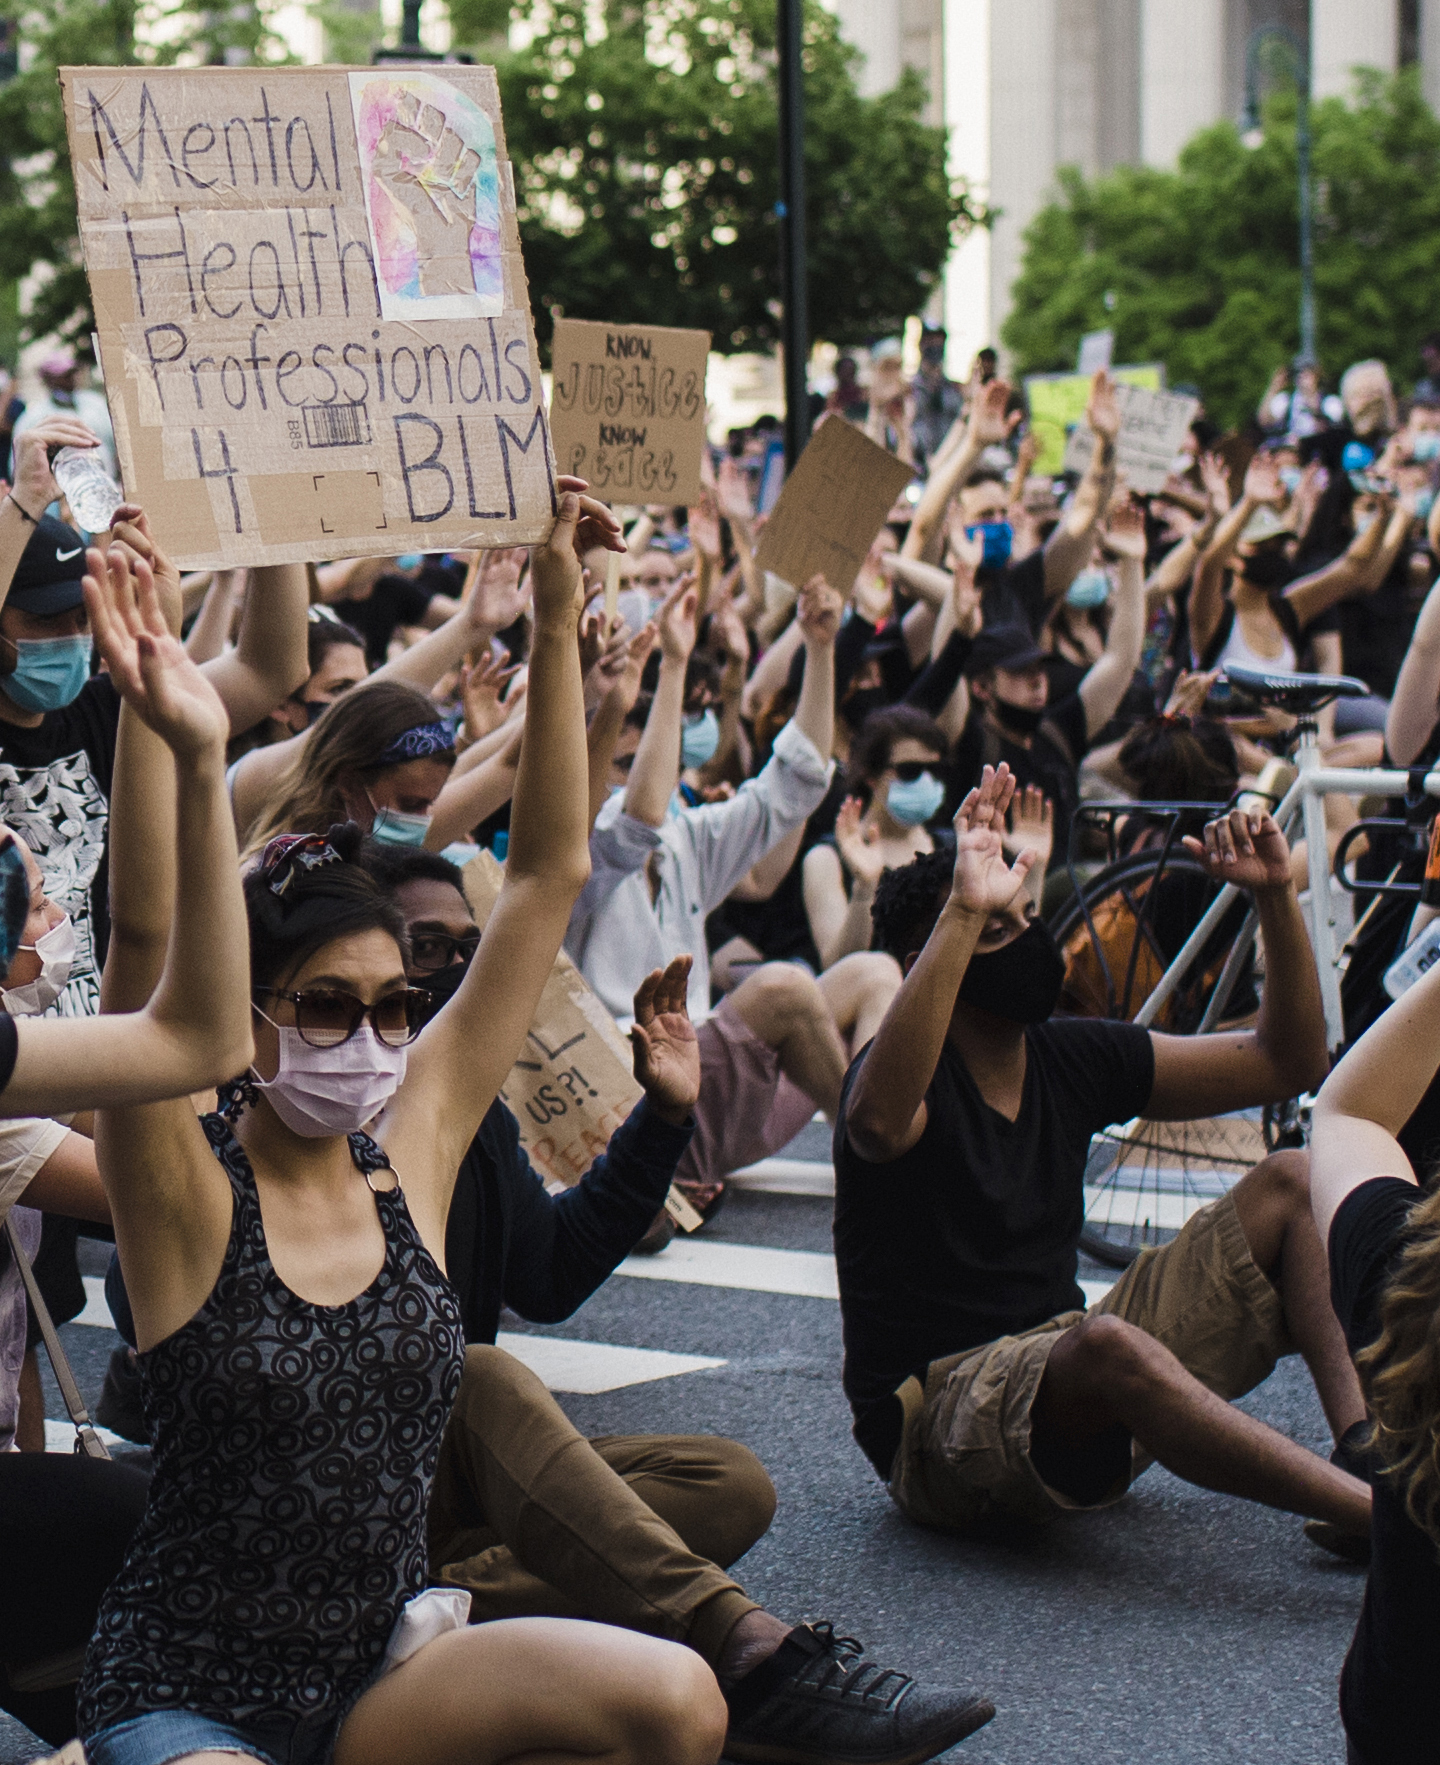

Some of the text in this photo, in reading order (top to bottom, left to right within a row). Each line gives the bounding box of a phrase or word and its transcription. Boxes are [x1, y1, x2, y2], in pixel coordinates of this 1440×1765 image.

[87, 81, 342, 193] Mental
[123, 204, 383, 321] Health
[144, 317, 533, 412] Professionals
[191, 405, 558, 533] 4 BLM
[599, 422, 647, 447] KNOW
